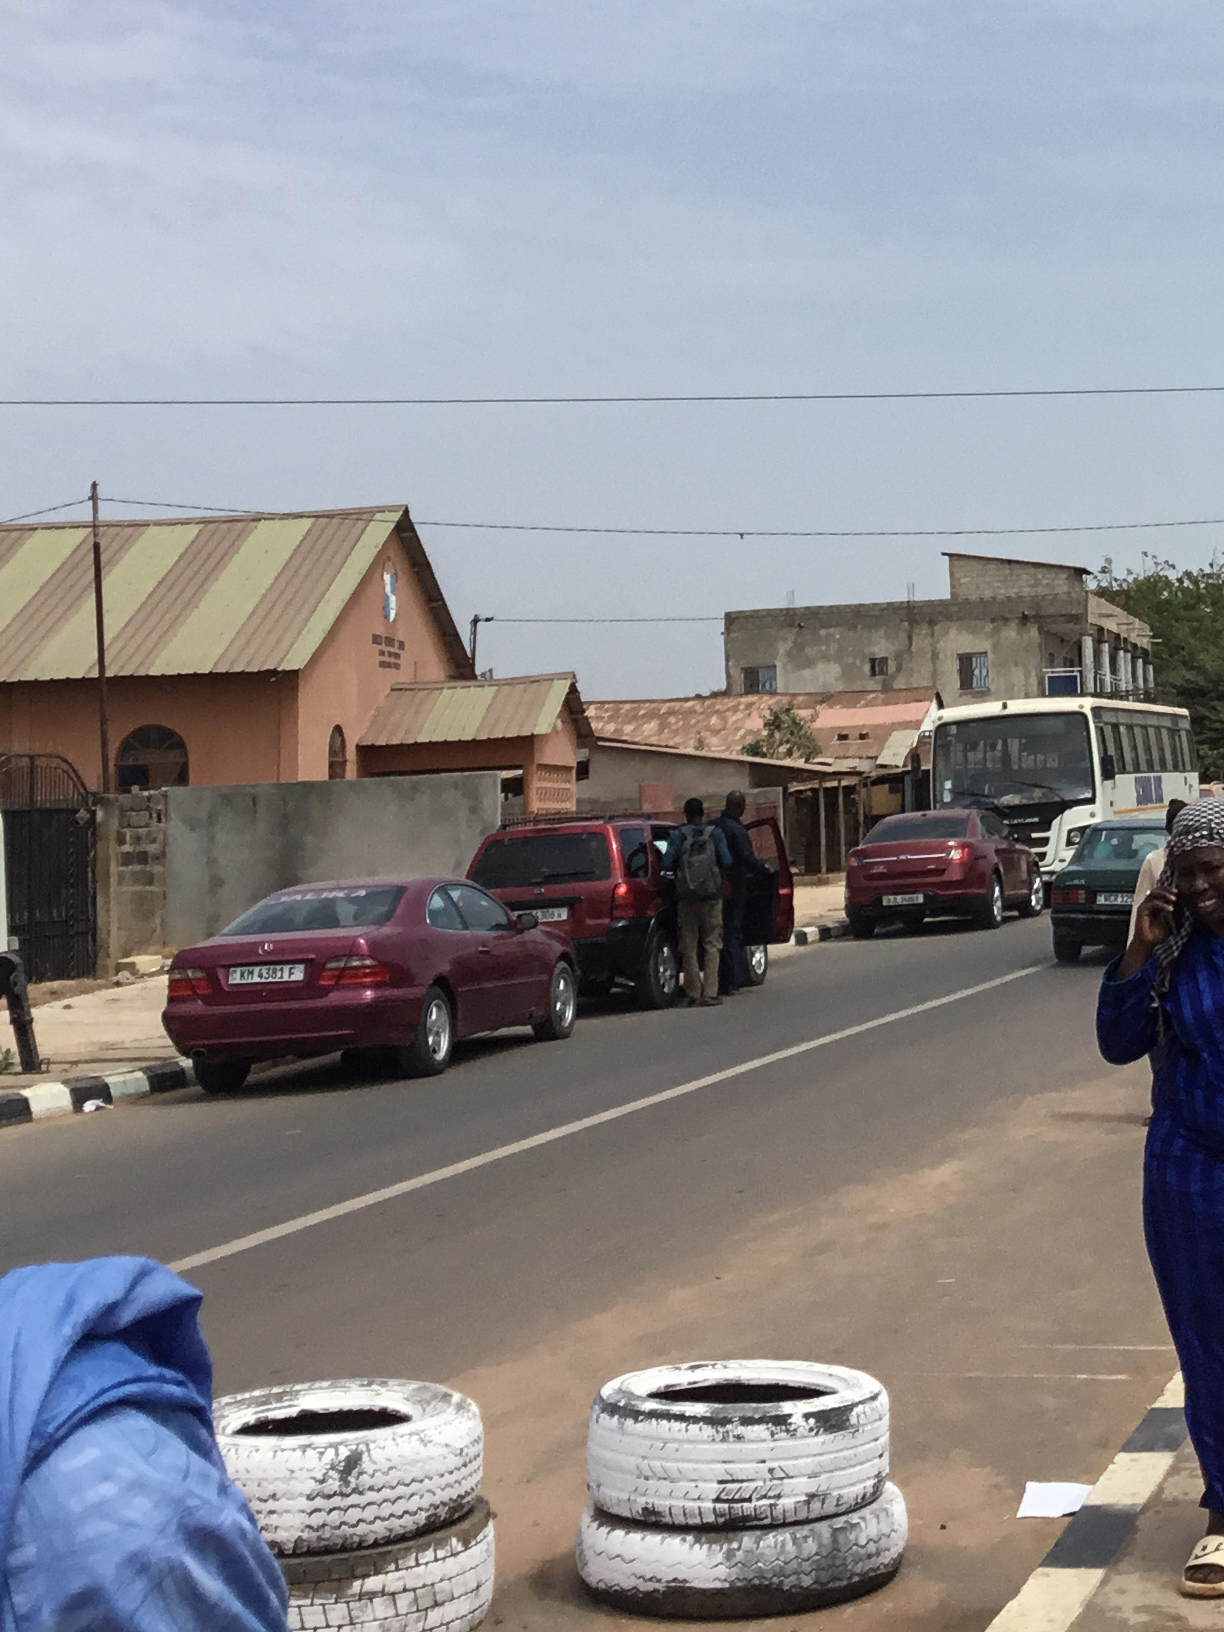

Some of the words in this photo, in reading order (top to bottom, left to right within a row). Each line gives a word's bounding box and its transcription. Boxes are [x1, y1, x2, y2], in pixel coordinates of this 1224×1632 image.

[239, 968, 254, 981] KM
[257, 966, 284, 980] 4381
[288, 966, 296, 979] F
